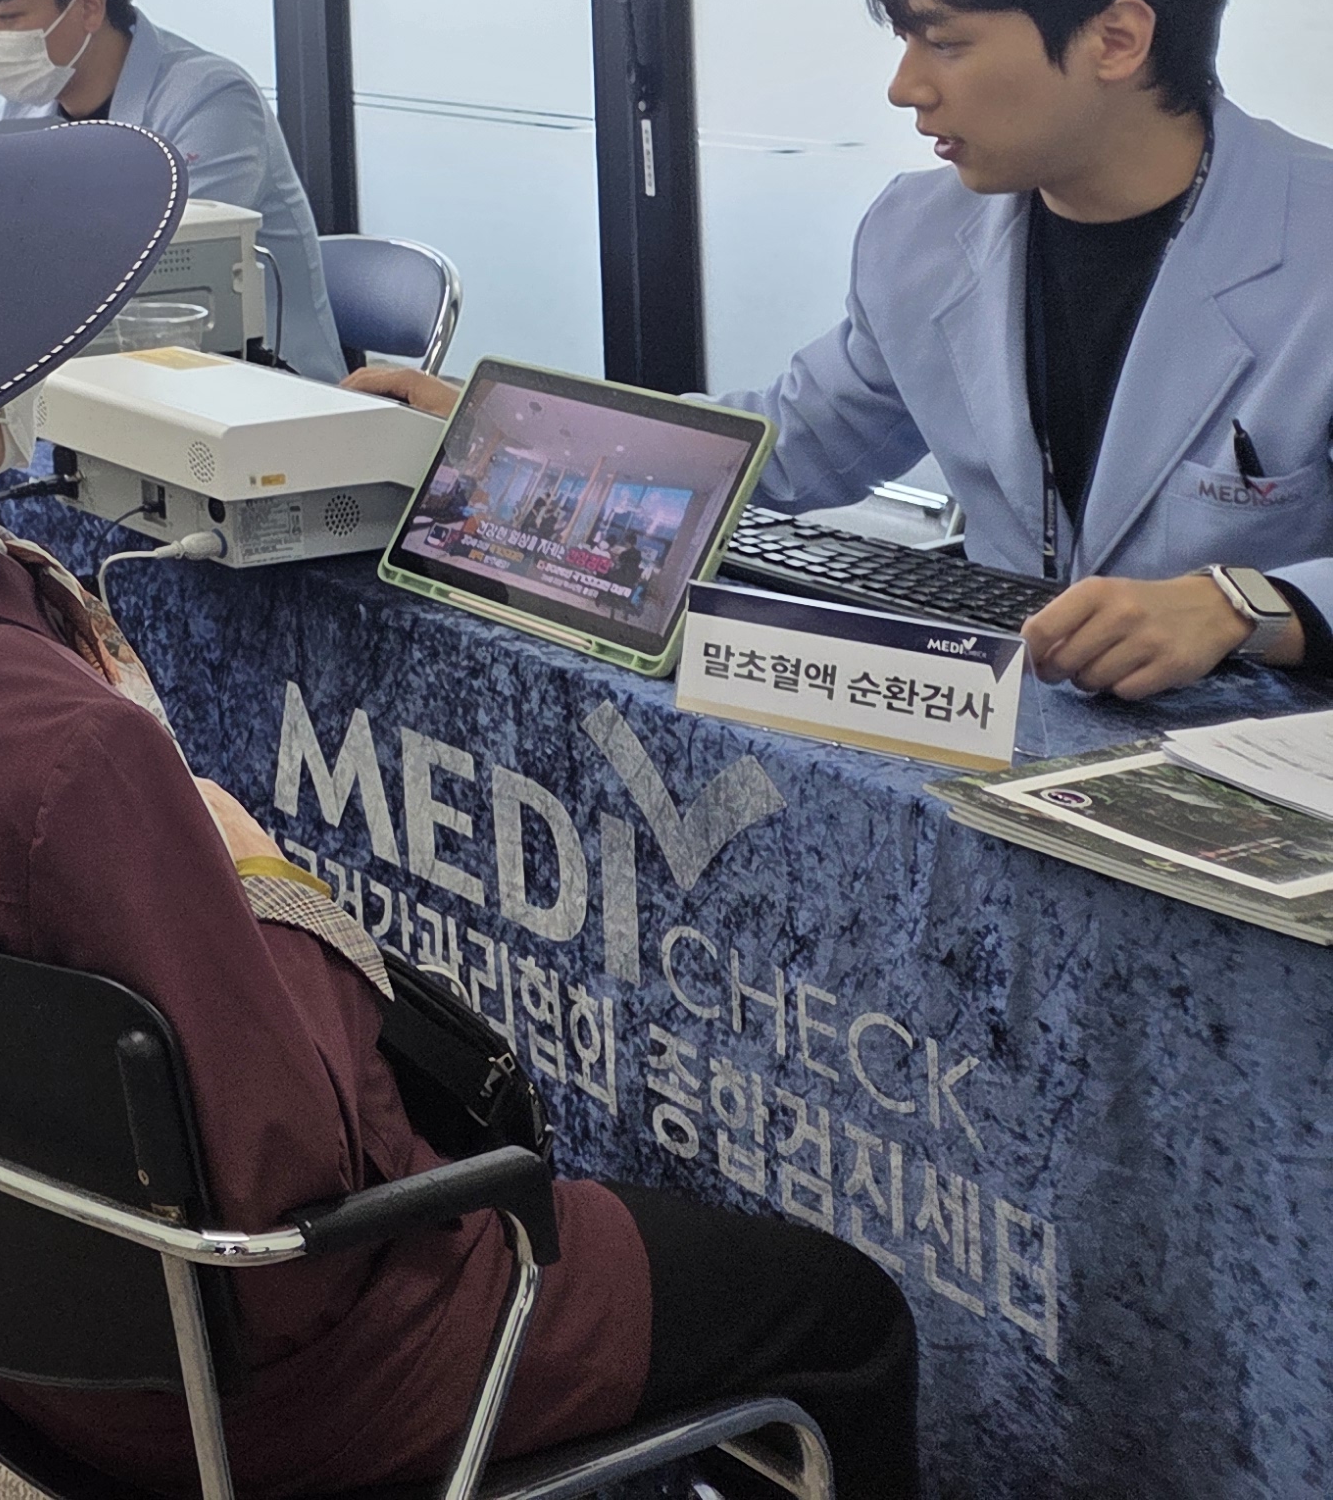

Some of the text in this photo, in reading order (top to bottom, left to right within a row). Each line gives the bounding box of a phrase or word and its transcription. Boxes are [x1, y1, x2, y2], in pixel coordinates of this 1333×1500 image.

[702, 642, 995, 730] 말초혈액 순환검사
[927, 638, 965, 655] MEDI
[274, 680, 986, 1153] MEDI CHECK
[646, 1022, 1059, 1366] 종합검진센터
